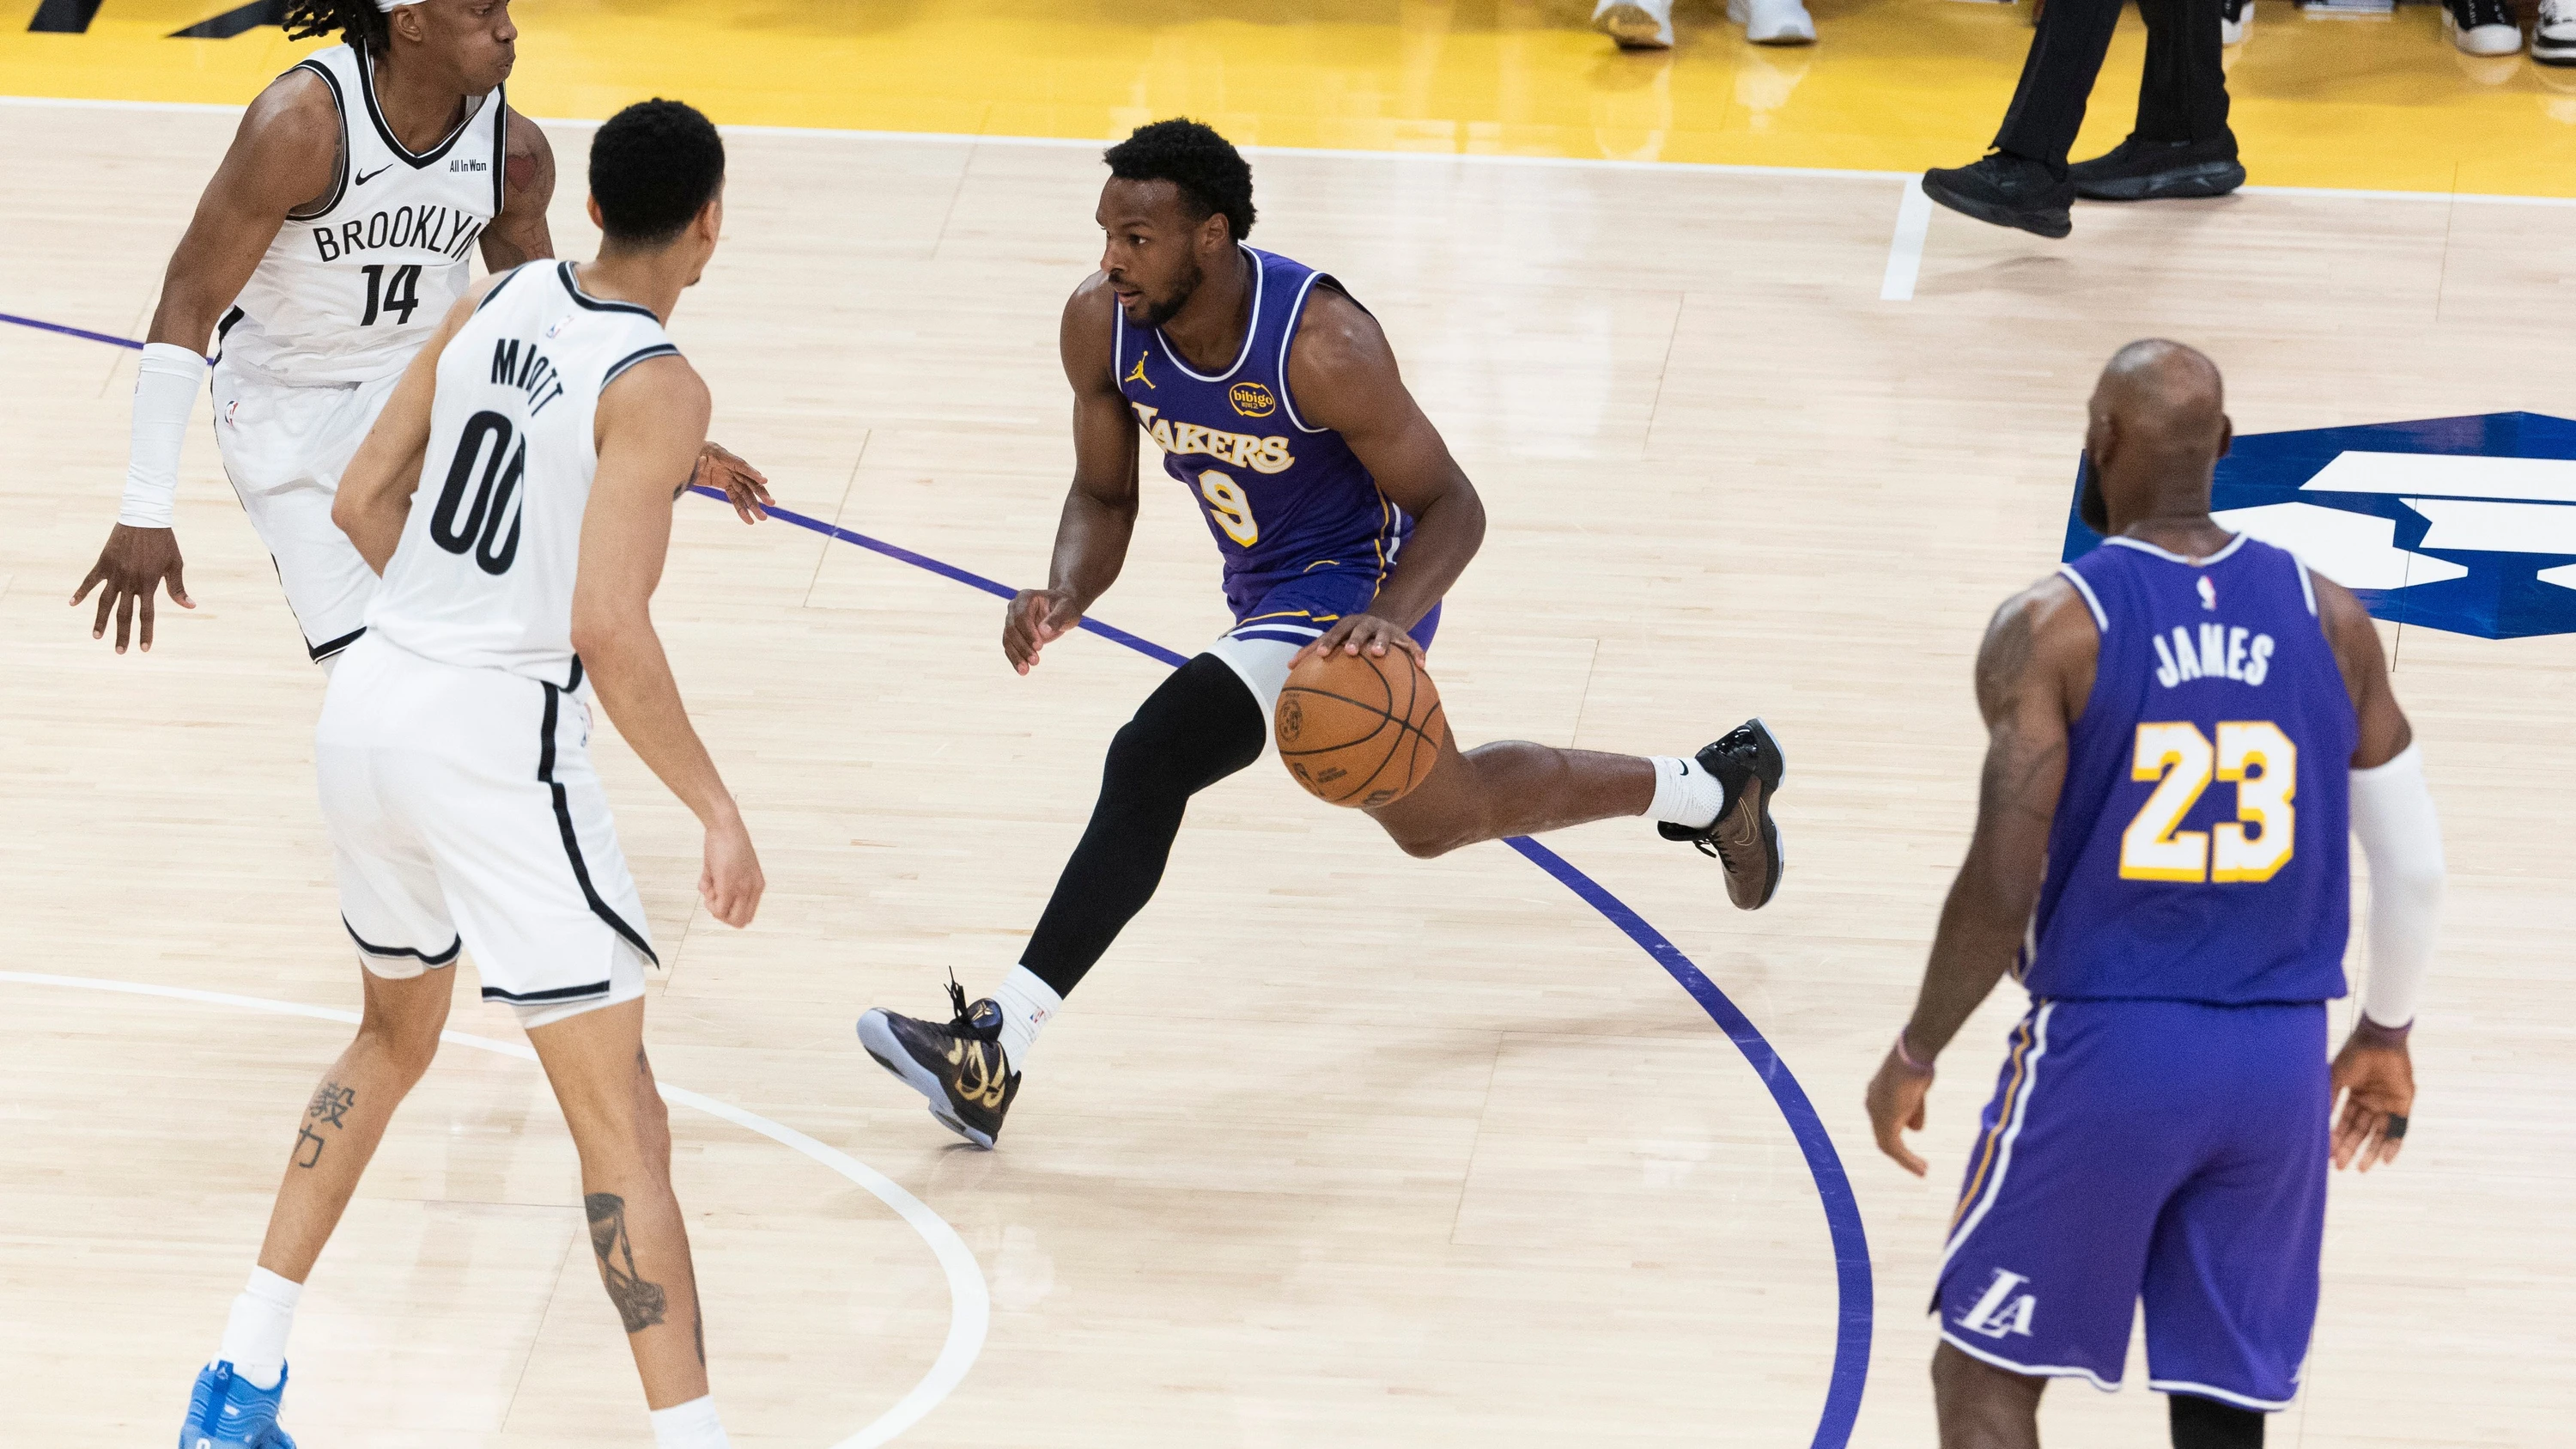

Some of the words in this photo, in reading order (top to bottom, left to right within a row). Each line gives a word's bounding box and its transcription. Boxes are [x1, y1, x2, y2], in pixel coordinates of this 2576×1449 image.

[449, 160, 459, 173] All
[460, 159, 469, 172] In
[469, 158, 487, 172] Won
[313, 204, 482, 262] BROOKLYN
[360, 265, 422, 326] 14
[1233, 389, 1273, 408] bibigo
[429, 410, 526, 576] 00
[1197, 469, 1259, 548] 9
[2152, 622, 2275, 688] JAMES
[2118, 720, 2298, 884] 23
[1953, 1266, 2037, 1339] LA
